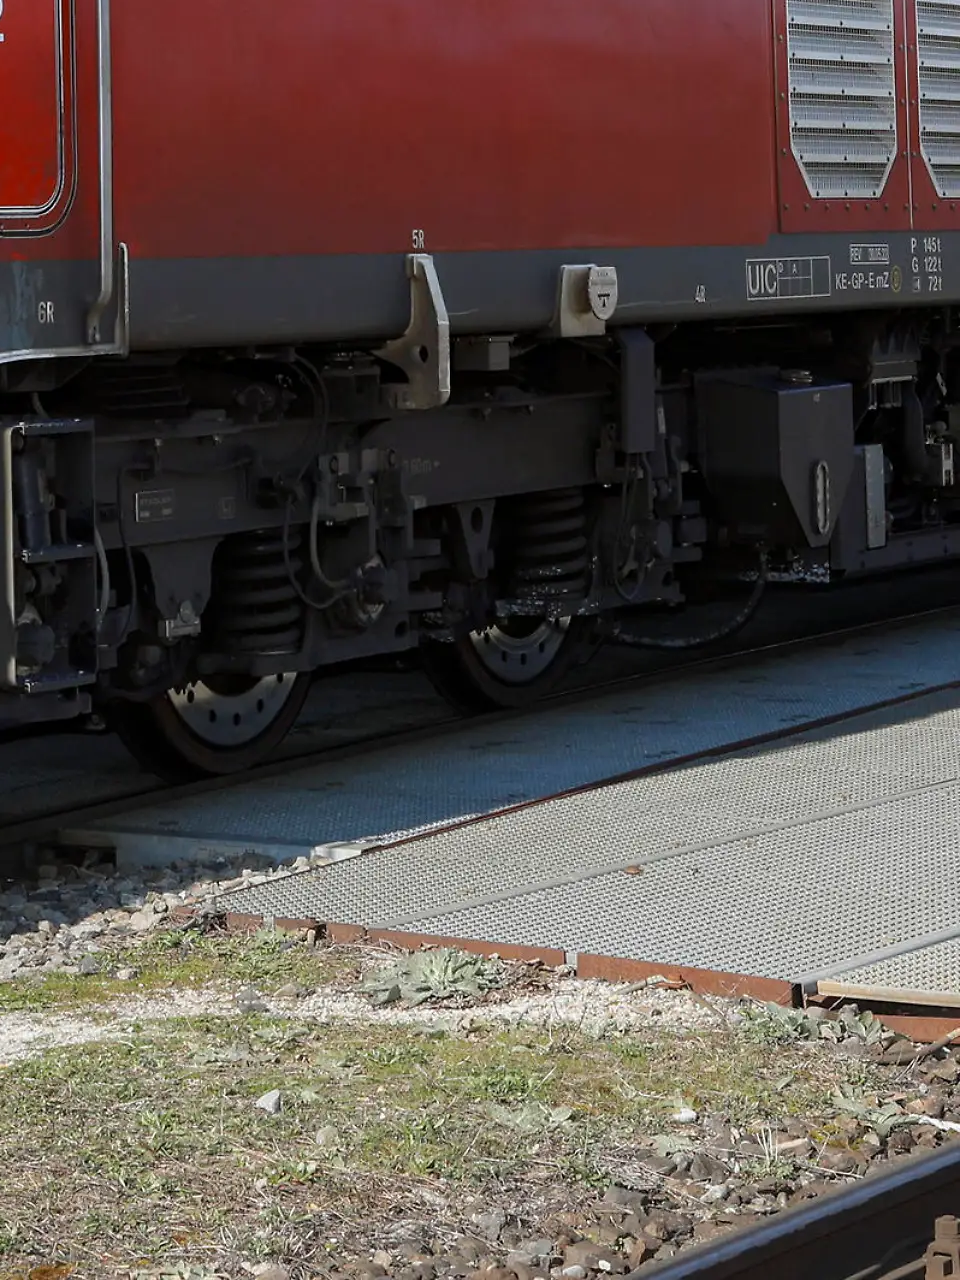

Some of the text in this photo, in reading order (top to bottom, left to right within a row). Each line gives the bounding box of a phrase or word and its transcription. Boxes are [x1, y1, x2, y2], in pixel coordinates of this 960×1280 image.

[412, 229, 425, 249] 5R
[911, 238, 917, 253] P
[911, 257, 919, 273] G
[747, 264, 777, 295] UIC
